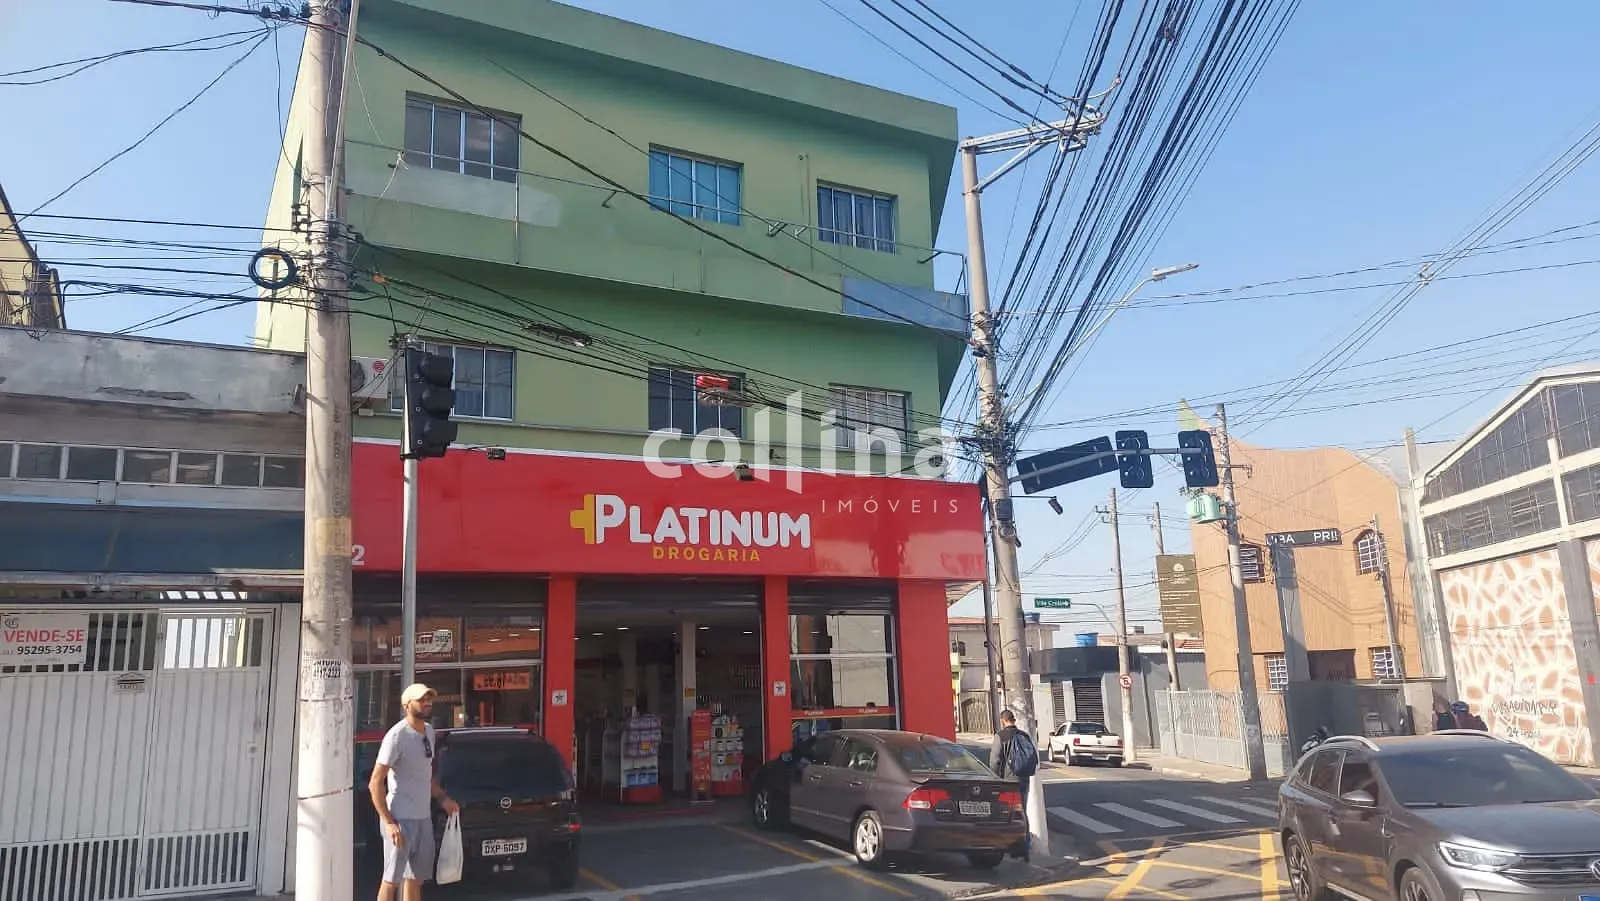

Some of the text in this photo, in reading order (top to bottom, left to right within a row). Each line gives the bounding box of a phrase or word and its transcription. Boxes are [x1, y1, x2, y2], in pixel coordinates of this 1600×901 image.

[595, 494, 811, 548] PLATINUM
[652, 546, 761, 562] DROGARIA
[4, 629, 85, 643] VENDE-SE
[17, 645, 82, 655] 95295-3754
[484, 841, 525, 854] DXP-6097
